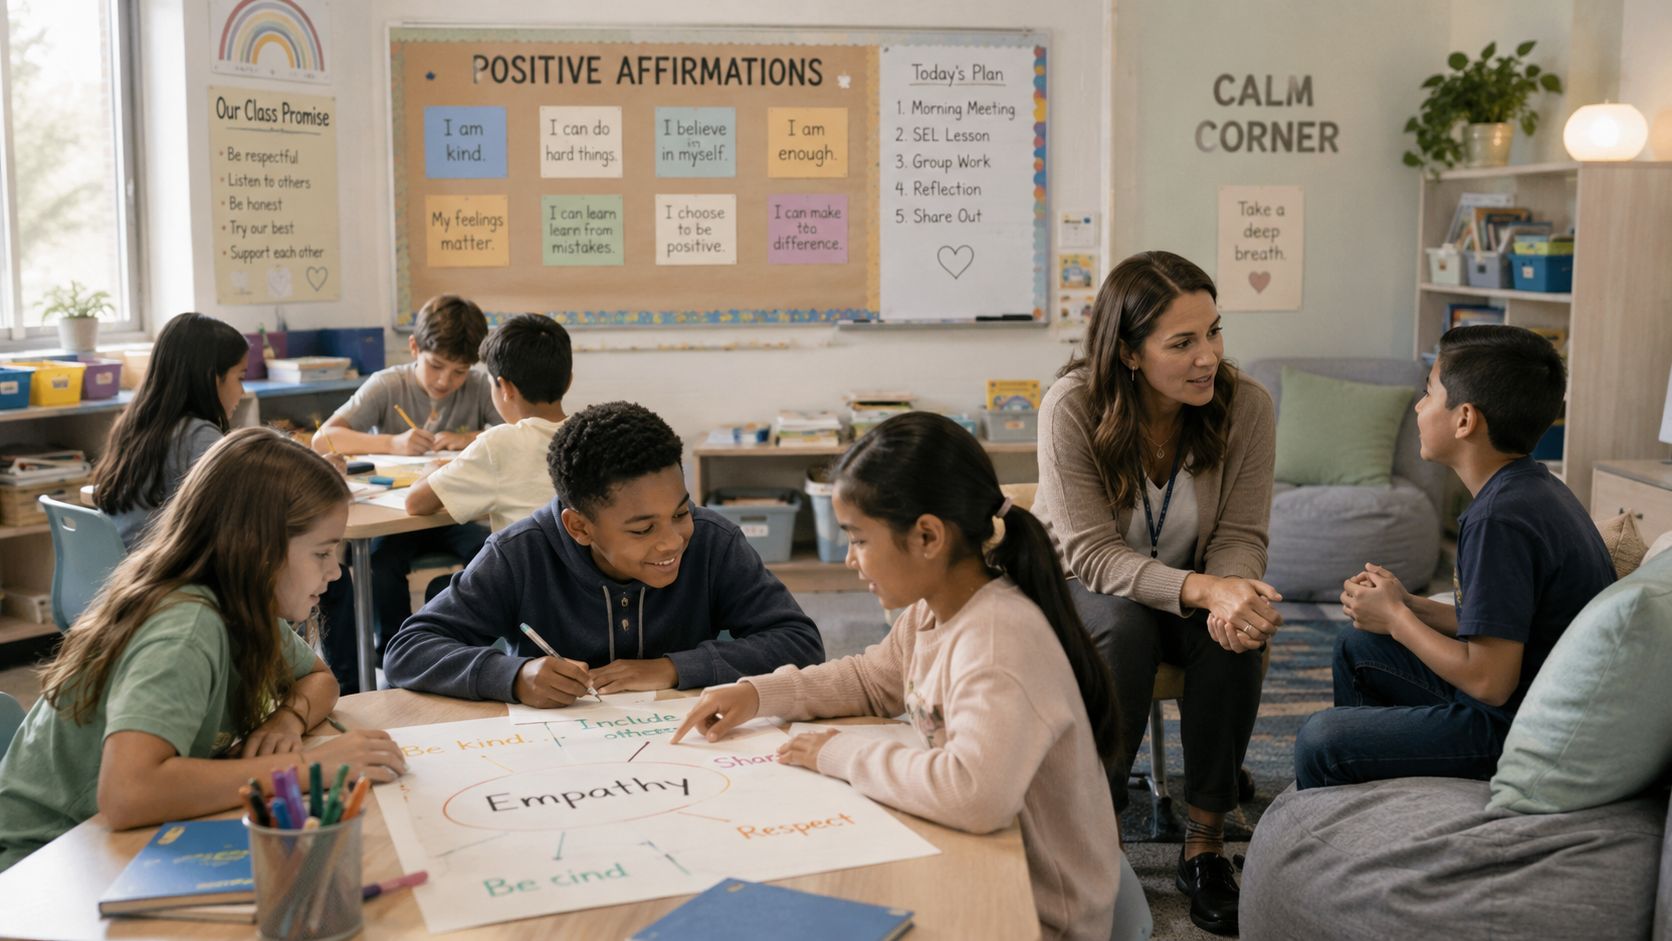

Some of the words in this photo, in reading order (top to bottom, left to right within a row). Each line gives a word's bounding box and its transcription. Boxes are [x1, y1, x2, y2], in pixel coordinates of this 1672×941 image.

[473, 55, 602, 84] POSITIVE
[616, 56, 823, 86] AFFIRMATIONS
[911, 64, 965, 87] Today's
[972, 64, 1003, 81] Plan
[1213, 74, 1313, 106] CALM
[216, 97, 240, 120] Our
[245, 99, 277, 123] Class
[282, 102, 329, 126] Promise
[897, 100, 905, 115] 1.
[912, 100, 962, 120] Morning
[967, 101, 1015, 120] Meeting
[444, 120, 453, 136] I
[459, 123, 483, 136] am
[549, 120, 557, 136] I
[563, 124, 588, 136] can
[593, 121, 610, 136] do
[664, 120, 671, 136] I
[677, 120, 727, 136] believe
[788, 120, 796, 136] I
[802, 125, 825, 136] am
[896, 127, 907, 142] 2.
[913, 127, 939, 142] SEL
[946, 128, 990, 142] Lesson
[1195, 120, 1339, 153] CORNER
[227, 146, 241, 162] Be
[245, 149, 298, 167] respectful
[446, 145, 486, 162] kind.
[546, 145, 574, 161] hard
[578, 146, 618, 167] things.
[662, 148, 673, 161] in
[679, 145, 728, 167] myself.
[778, 145, 837, 167] enough.
[896, 154, 907, 169] 3.
[912, 154, 952, 173] Group
[957, 154, 991, 168] Work
[228, 173, 260, 187] Listen
[264, 177, 275, 189] to
[278, 176, 311, 189] others
[895, 182, 908, 196] 4.
[914, 180, 981, 196] Reflection
[229, 196, 243, 210] Be
[247, 197, 282, 211] honest
[666, 205, 672, 219] I
[678, 206, 725, 219] choose
[775, 204, 781, 219] I
[785, 209, 806, 219] can
[810, 205, 841, 219] make
[1237, 200, 1271, 216] Take
[1276, 206, 1285, 216] a
[432, 211, 450, 232] My
[455, 209, 503, 232] feelings
[549, 206, 556, 220] I
[561, 209, 583, 220] can
[587, 206, 616, 220] learn
[896, 209, 908, 224] 5.
[914, 208, 952, 223] Share
[958, 209, 982, 223] Out
[230, 220, 247, 238] Try
[251, 224, 268, 234] our
[272, 221, 294, 235] best
[550, 224, 580, 236] learn
[585, 223, 613, 236] from
[678, 224, 691, 235] to
[696, 223, 712, 235] be
[1243, 222, 1280, 243] deep
[441, 236, 494, 251] matter.
[552, 240, 615, 254] mistakes.
[667, 239, 725, 258] positive.
[773, 236, 842, 250] difference.
[231, 246, 270, 264] Support
[273, 247, 297, 259] each
[299, 246, 324, 259] other
[575, 713, 681, 730] Include
[401, 743, 445, 757] Be
[713, 754, 775, 769] Shar
[485, 777, 690, 812] Empathy
[736, 812, 856, 840] Respect
[483, 877, 542, 898] Be
